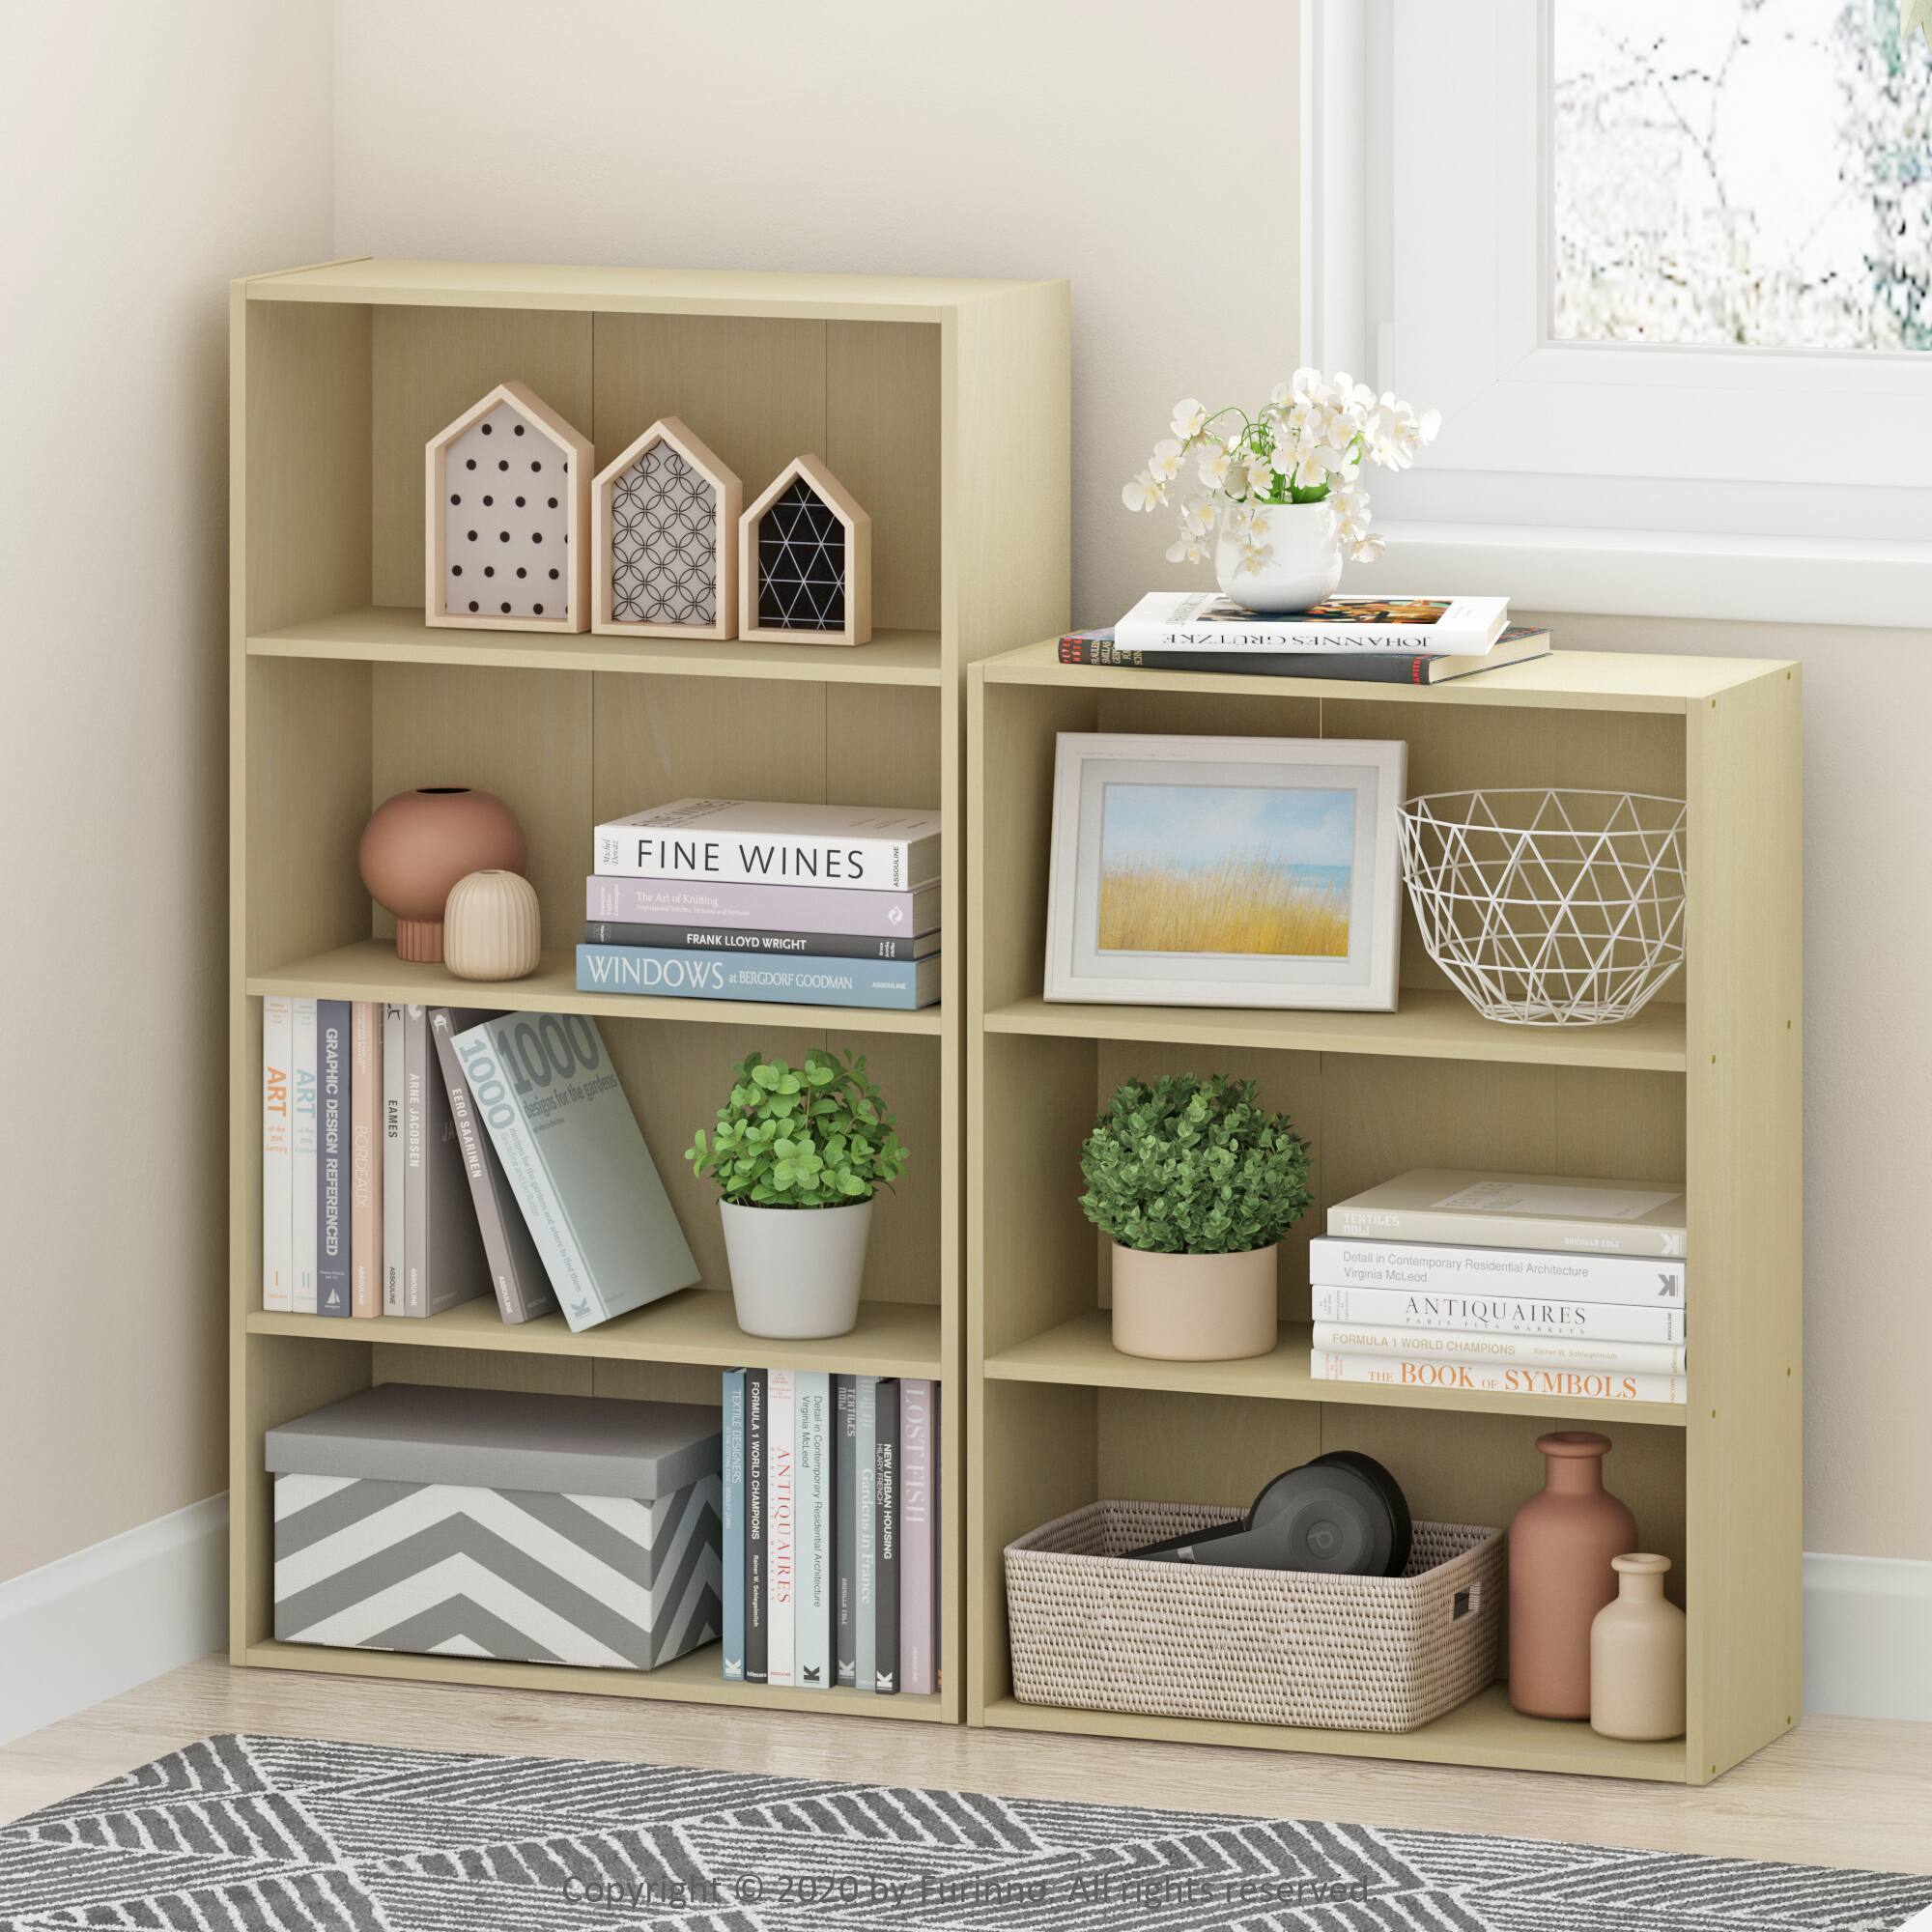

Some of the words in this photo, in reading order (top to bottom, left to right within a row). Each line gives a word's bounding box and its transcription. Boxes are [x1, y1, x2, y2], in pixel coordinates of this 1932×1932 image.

[1293, 635, 1432, 648] JOHANNES
[638, 839, 720, 871] FINE
[739, 844, 865, 879] WINES
[637, 892, 653, 902] The
[655, 893, 671, 903] Art
[672, 893, 682, 903] of
[682, 895, 719, 907] Knitting
[687, 933, 721, 946] FRANK
[724, 935, 760, 948] LLOYD
[762, 937, 808, 951] WRIGHT
[586, 955, 724, 990] WINDOWS
[728, 974, 737, 983] at
[739, 971, 794, 987] BERGDORF
[796, 974, 853, 990] GOODMAN
[872, 981, 907, 990] ASSOULINE
[326, 1028, 338, 1095] GRAPHIC
[497, 1013, 600, 1096] 1000
[268, 1066, 287, 1118] ART
[297, 1068, 316, 1119] ART
[410, 1073, 419, 1104] ARNE
[459, 1038, 515, 1130] 1000
[524, 1093, 558, 1120] designs
[555, 1091, 571, 1109] for
[568, 1083, 583, 1102] the
[582, 1074, 618, 1103] gardens
[326, 1098, 338, 1153] DESIGN
[388, 1099, 398, 1138] EAMES
[410, 1107, 419, 1168] JACOBSEN
[451, 1088, 469, 1119] EERO
[460, 1121, 482, 1179] SAARINEN
[265, 1145, 288, 1154] Century
[355, 1125, 369, 1208] BORDEAUX
[326, 1158, 338, 1257] REFERENCED
[1344, 1212, 1400, 1227] TEXTILES
[1343, 1251, 1373, 1264] Detail
[1376, 1253, 1384, 1264] in
[1387, 1254, 1462, 1271] Contemporary
[1465, 1259, 1522, 1273] Residential
[1525, 1263, 1589, 1277] Architecture
[1344, 1266, 1382, 1281] Virginia
[1386, 1270, 1428, 1283] McLeod
[497, 1275, 514, 1315] ASSOULINE
[1406, 1296, 1586, 1326] ANTIQUAIRES
[1406, 1318, 1451, 1326] PARIS
[1332, 1333, 1388, 1347] FORMULA
[1393, 1337, 1398, 1348] 1
[1402, 1338, 1443, 1350] WORLD
[1446, 1341, 1516, 1355] CHAMPIONS
[1533, 1347, 1555, 1355] Rainer
[1368, 1371, 1393, 1382] THE
[1400, 1362, 1475, 1388] BOOK
[1482, 1379, 1497, 1389] OF
[1505, 1369, 1637, 1400] SYMBOLS
[732, 1390, 742, 1428] TEXTILE
[752, 1381, 760, 1431] FORMULA
[800, 1396, 810, 1430] Virginia
[813, 1396, 822, 1422] Detail
[847, 1388, 857, 1437] TEXTILES
[905, 1389, 925, 1458] LOST
[732, 1430, 742, 1485] DESIGNERS
[752, 1441, 760, 1478] WORLD
[802, 1431, 810, 1469] McLeod
[811, 1435, 822, 1499] Contemporary
[883, 1444, 893, 1469] NEW
[752, 1480, 760, 1540] CHAMPIONS
[862, 1467, 873, 1531] Gardens
[883, 1471, 893, 1509] URBAN
[905, 1464, 925, 1522] FISH
[774, 1447, 791, 1604] ANTIQUAIRES
[813, 1501, 823, 1551] Residential
[862, 1534, 874, 1548] in
[883, 1511, 893, 1560] HOUSING
[813, 1553, 823, 1608] Architecture
[862, 1552, 874, 1605] France
